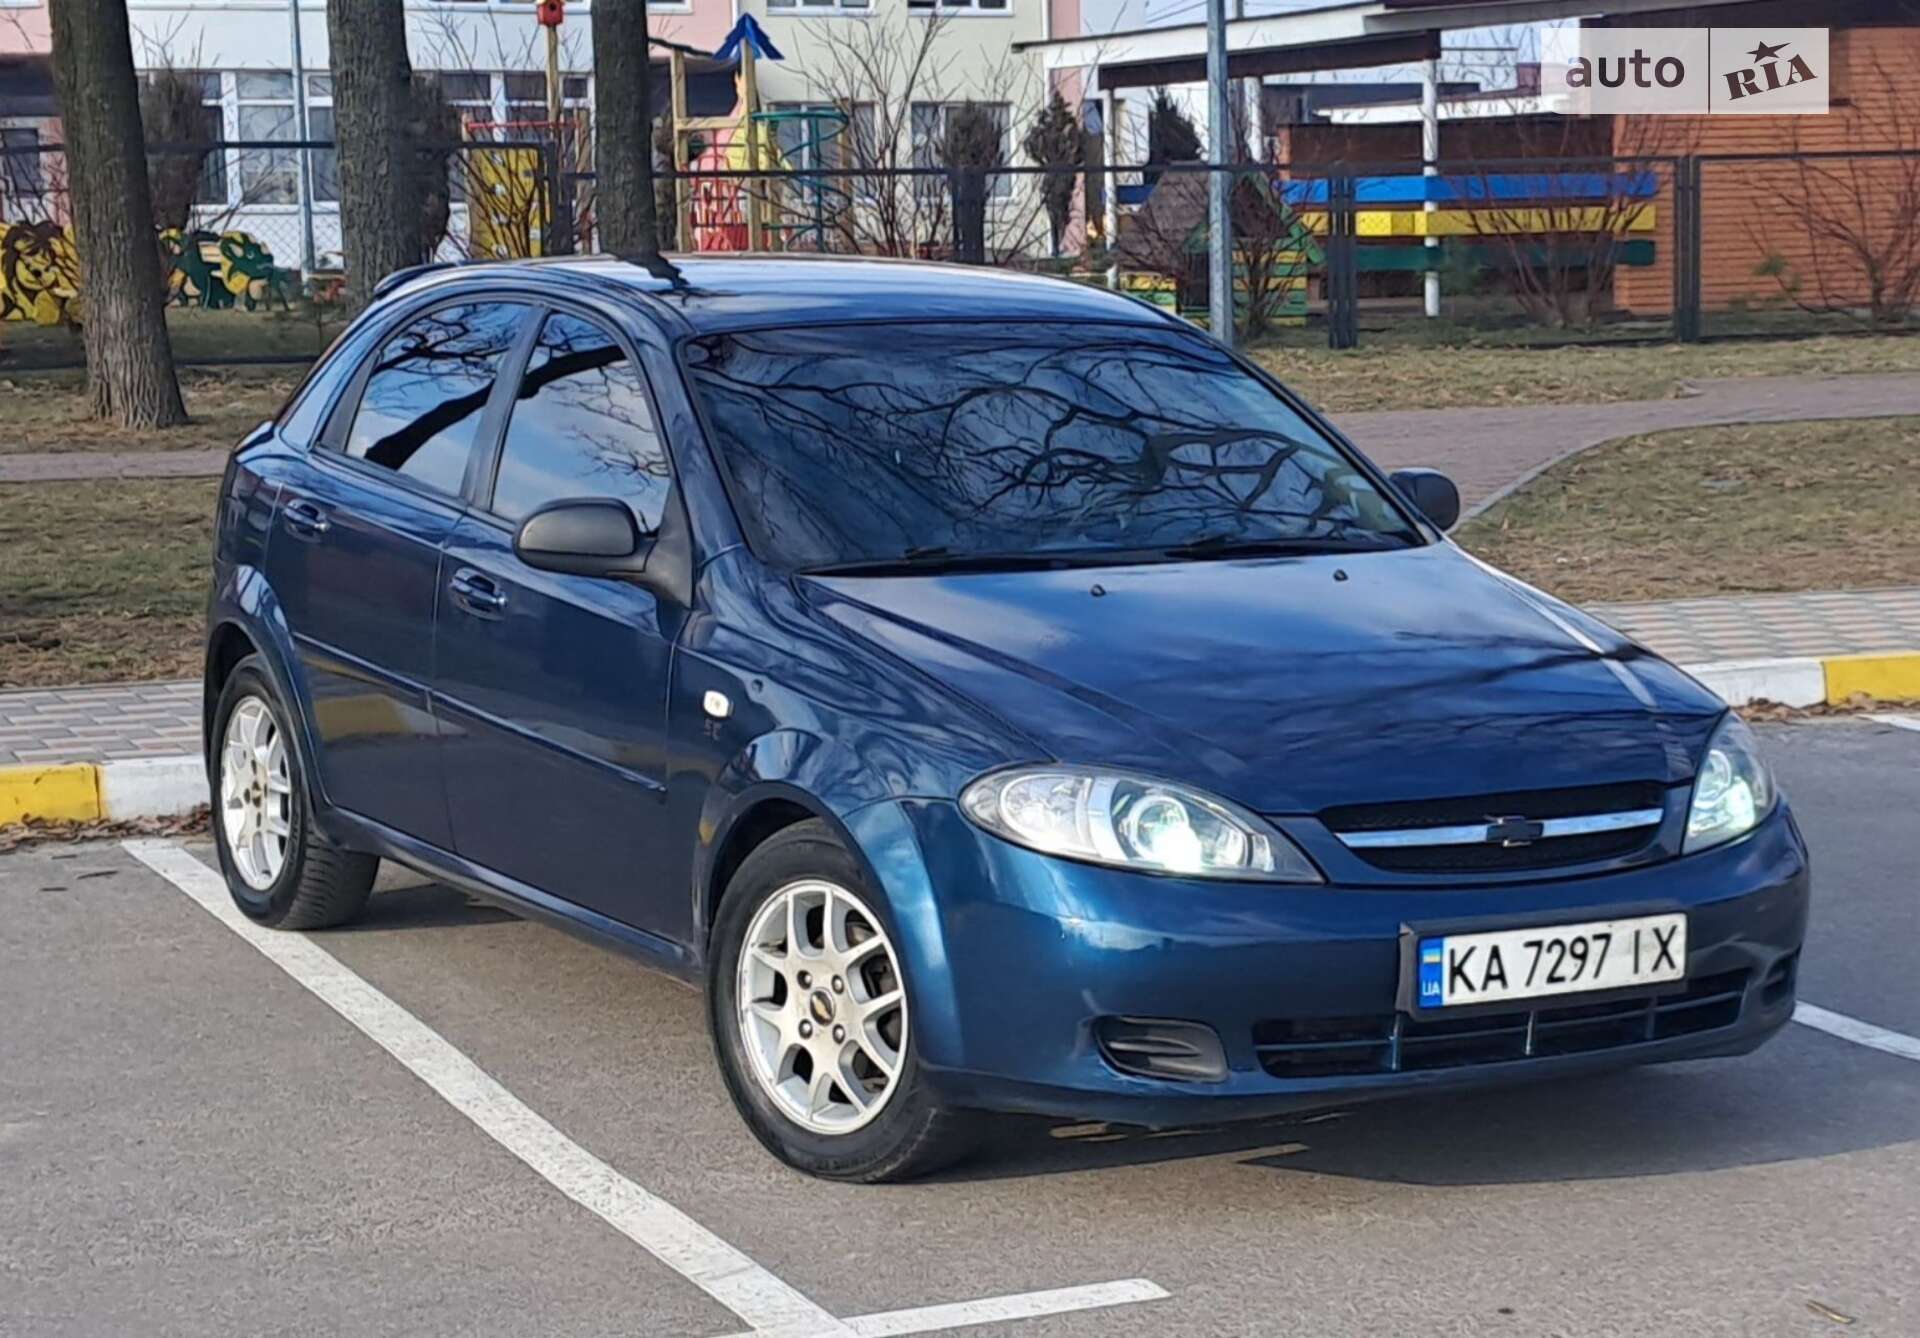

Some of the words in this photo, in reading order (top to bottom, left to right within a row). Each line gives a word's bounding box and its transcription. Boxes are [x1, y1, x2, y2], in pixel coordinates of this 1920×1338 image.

[1449, 945, 1508, 995] KA
[1523, 932, 1611, 987] 7297
[1632, 924, 1678, 974] IX
[1422, 980, 1440, 997] UA
